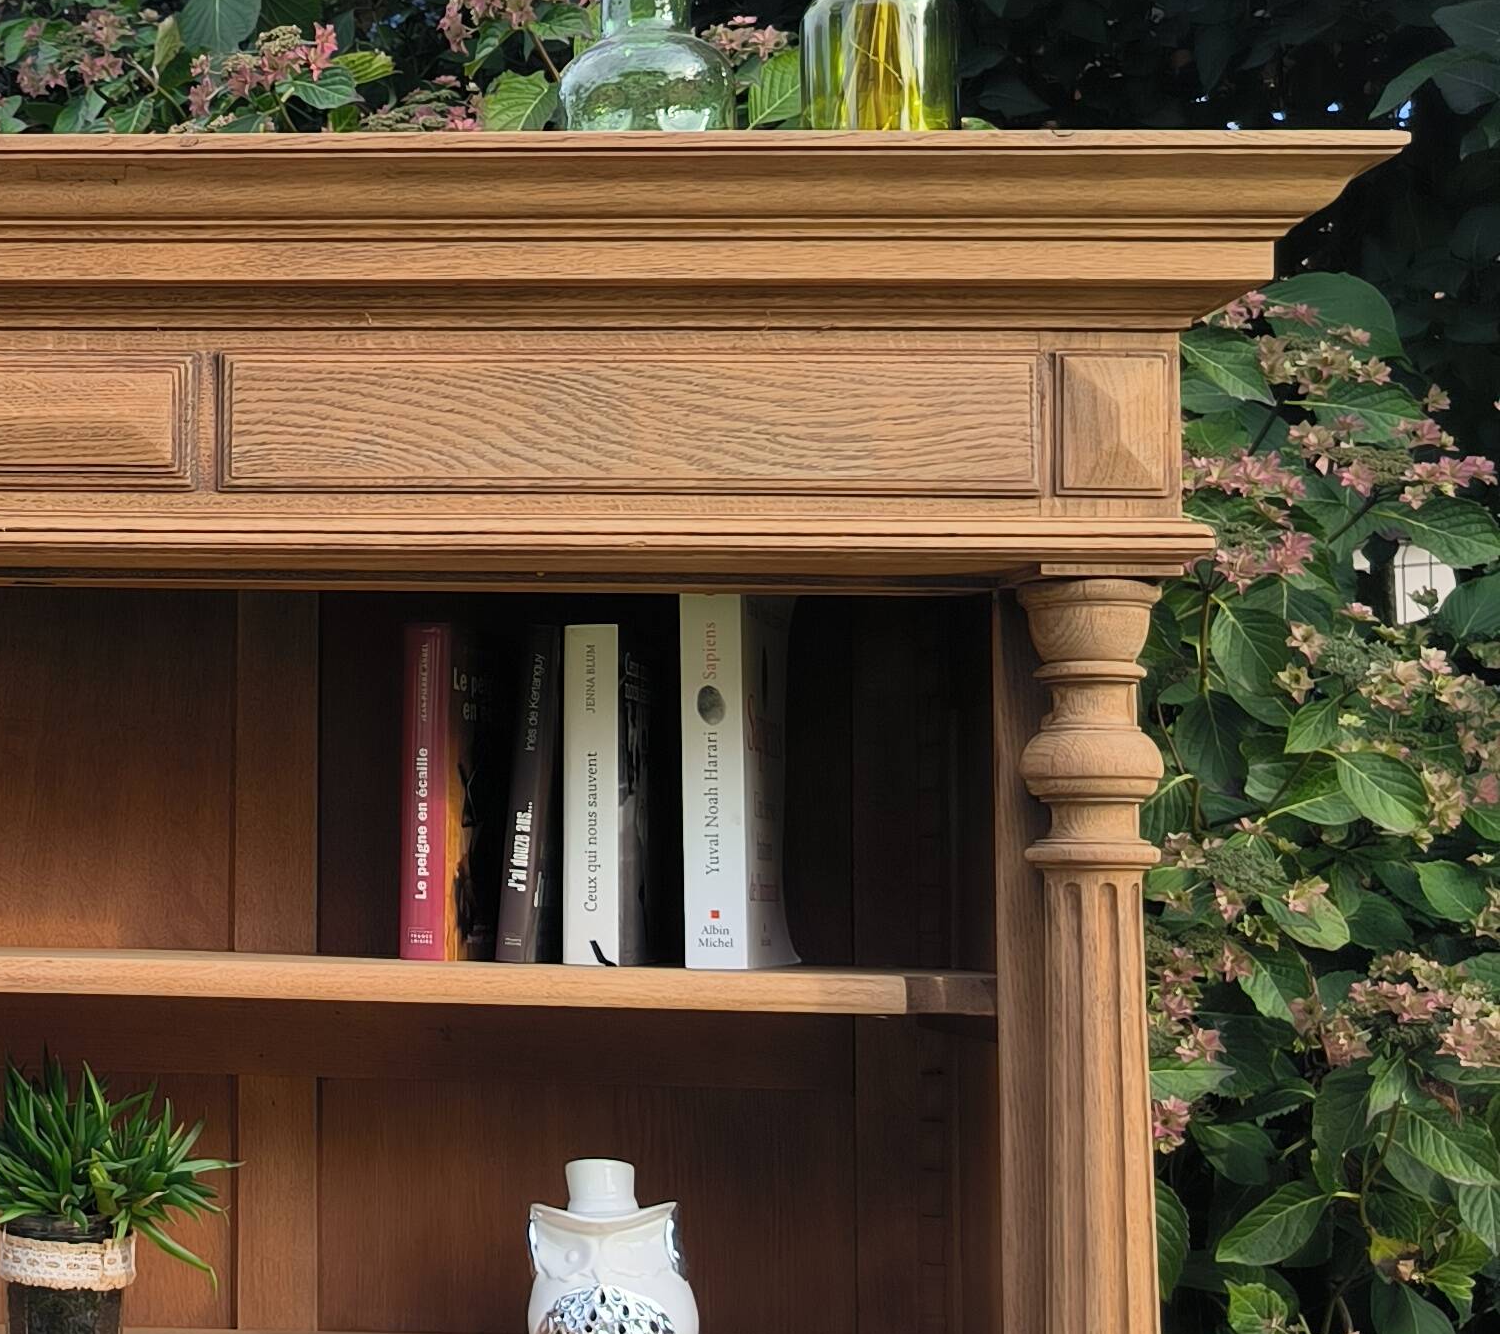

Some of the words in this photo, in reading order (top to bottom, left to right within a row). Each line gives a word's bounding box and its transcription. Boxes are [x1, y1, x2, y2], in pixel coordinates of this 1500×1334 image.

[585, 644, 597, 675] BLUM
[701, 621, 720, 681] Sapiens
[585, 677, 597, 714] JENNA
[526, 711, 539, 726] de
[414, 747, 428, 798] écaille
[702, 731, 719, 782] Harari
[586, 751, 598, 808] sauvent
[416, 802, 428, 821] en
[703, 787, 720, 828] Noah
[586, 811, 598, 846] nous
[415, 825, 430, 877] peigne
[509, 834, 531, 867] douze
[585, 849, 601, 873] qui
[703, 832, 721, 876] Yuval
[414, 888, 428, 900] Le
[507, 869, 528, 892] J'ai
[584, 876, 598, 912] Ceux
[698, 937, 734, 949] Michel
[700, 925, 731, 936] Albin
